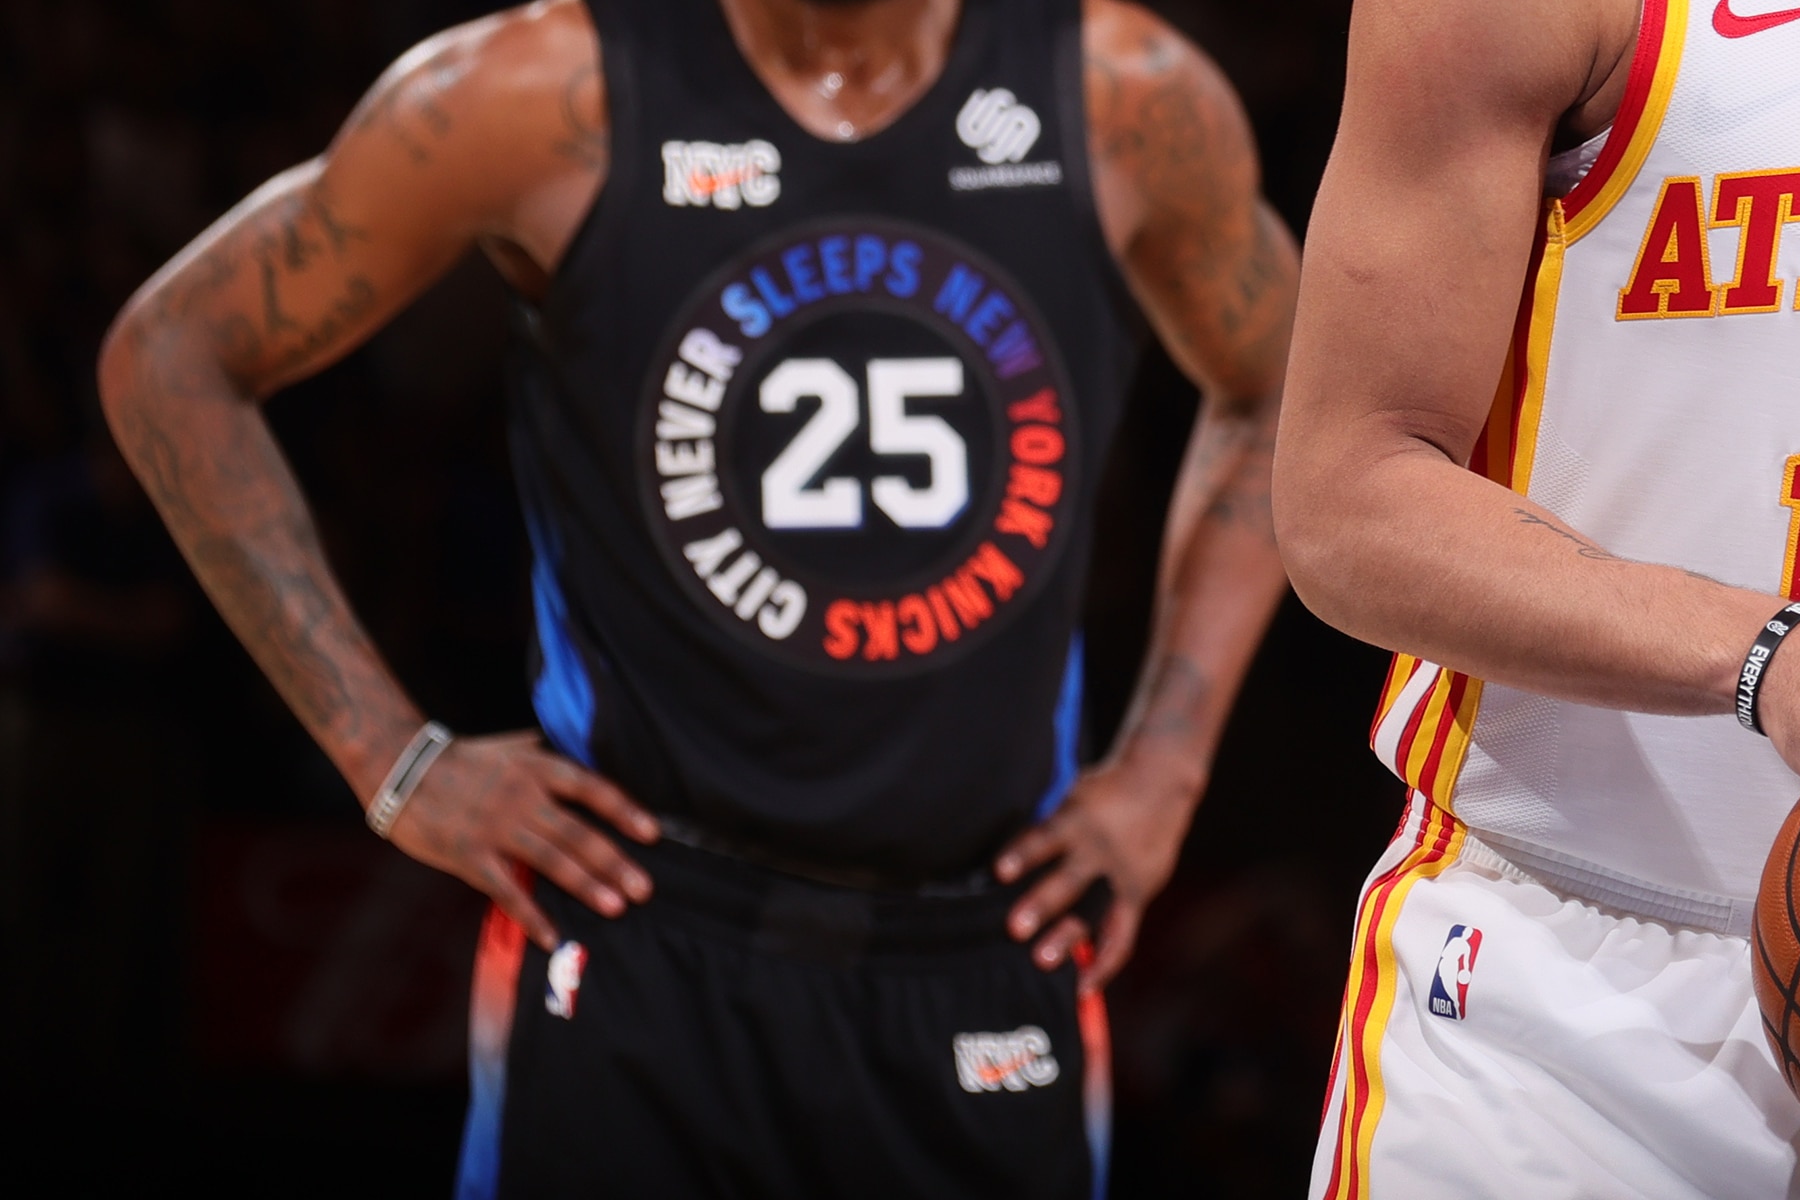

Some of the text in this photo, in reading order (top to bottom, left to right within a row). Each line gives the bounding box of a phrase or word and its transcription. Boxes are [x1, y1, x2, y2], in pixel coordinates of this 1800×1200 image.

[661, 139, 782, 211] NYC
[933, 263, 1041, 380] NEW
[654, 235, 925, 640] CITY NEVER SLEEPS
[758, 356, 973, 530] 25
[995, 387, 1067, 550] YORK
[823, 540, 1026, 661] KNICKS
[952, 1024, 1060, 1093] NYC
[1432, 996, 1453, 1017] NBA
